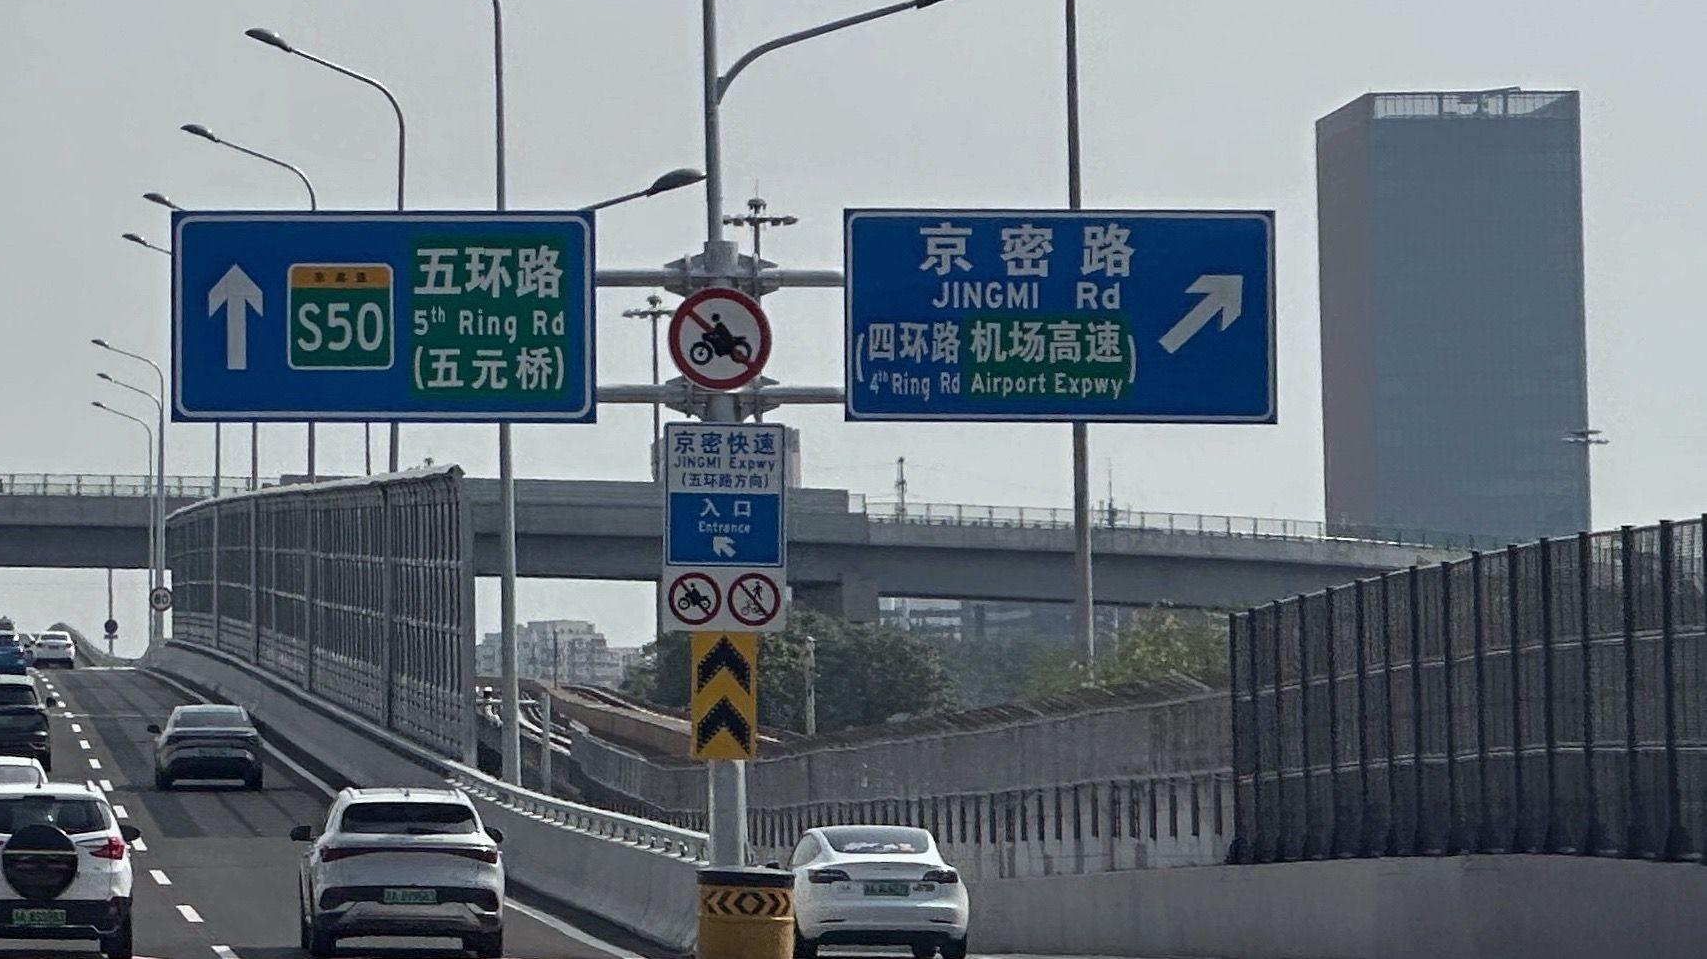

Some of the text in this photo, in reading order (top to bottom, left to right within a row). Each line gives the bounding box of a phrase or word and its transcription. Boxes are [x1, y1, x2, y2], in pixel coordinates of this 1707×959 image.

[919, 222, 1136, 278] 京密路
[413, 244, 565, 299] 五环路
[932, 282, 1121, 309] JINGMI Rd
[297, 302, 384, 351] S50
[414, 306, 565, 344] 5th Ring Rd
[413, 346, 565, 391] (五元桥)
[891, 370, 930, 402] Ring
[939, 371, 961, 395] Rd
[971, 373, 1047, 402] Airport
[1053, 372, 1124, 400] Expwy
[673, 431, 775, 455] 京密快速
[673, 455, 775, 472] JINGMI Expwy
[681, 473, 769, 489] (五环路方向)
[700, 498, 752, 518] 入口
[698, 520, 751, 534] Entrance
